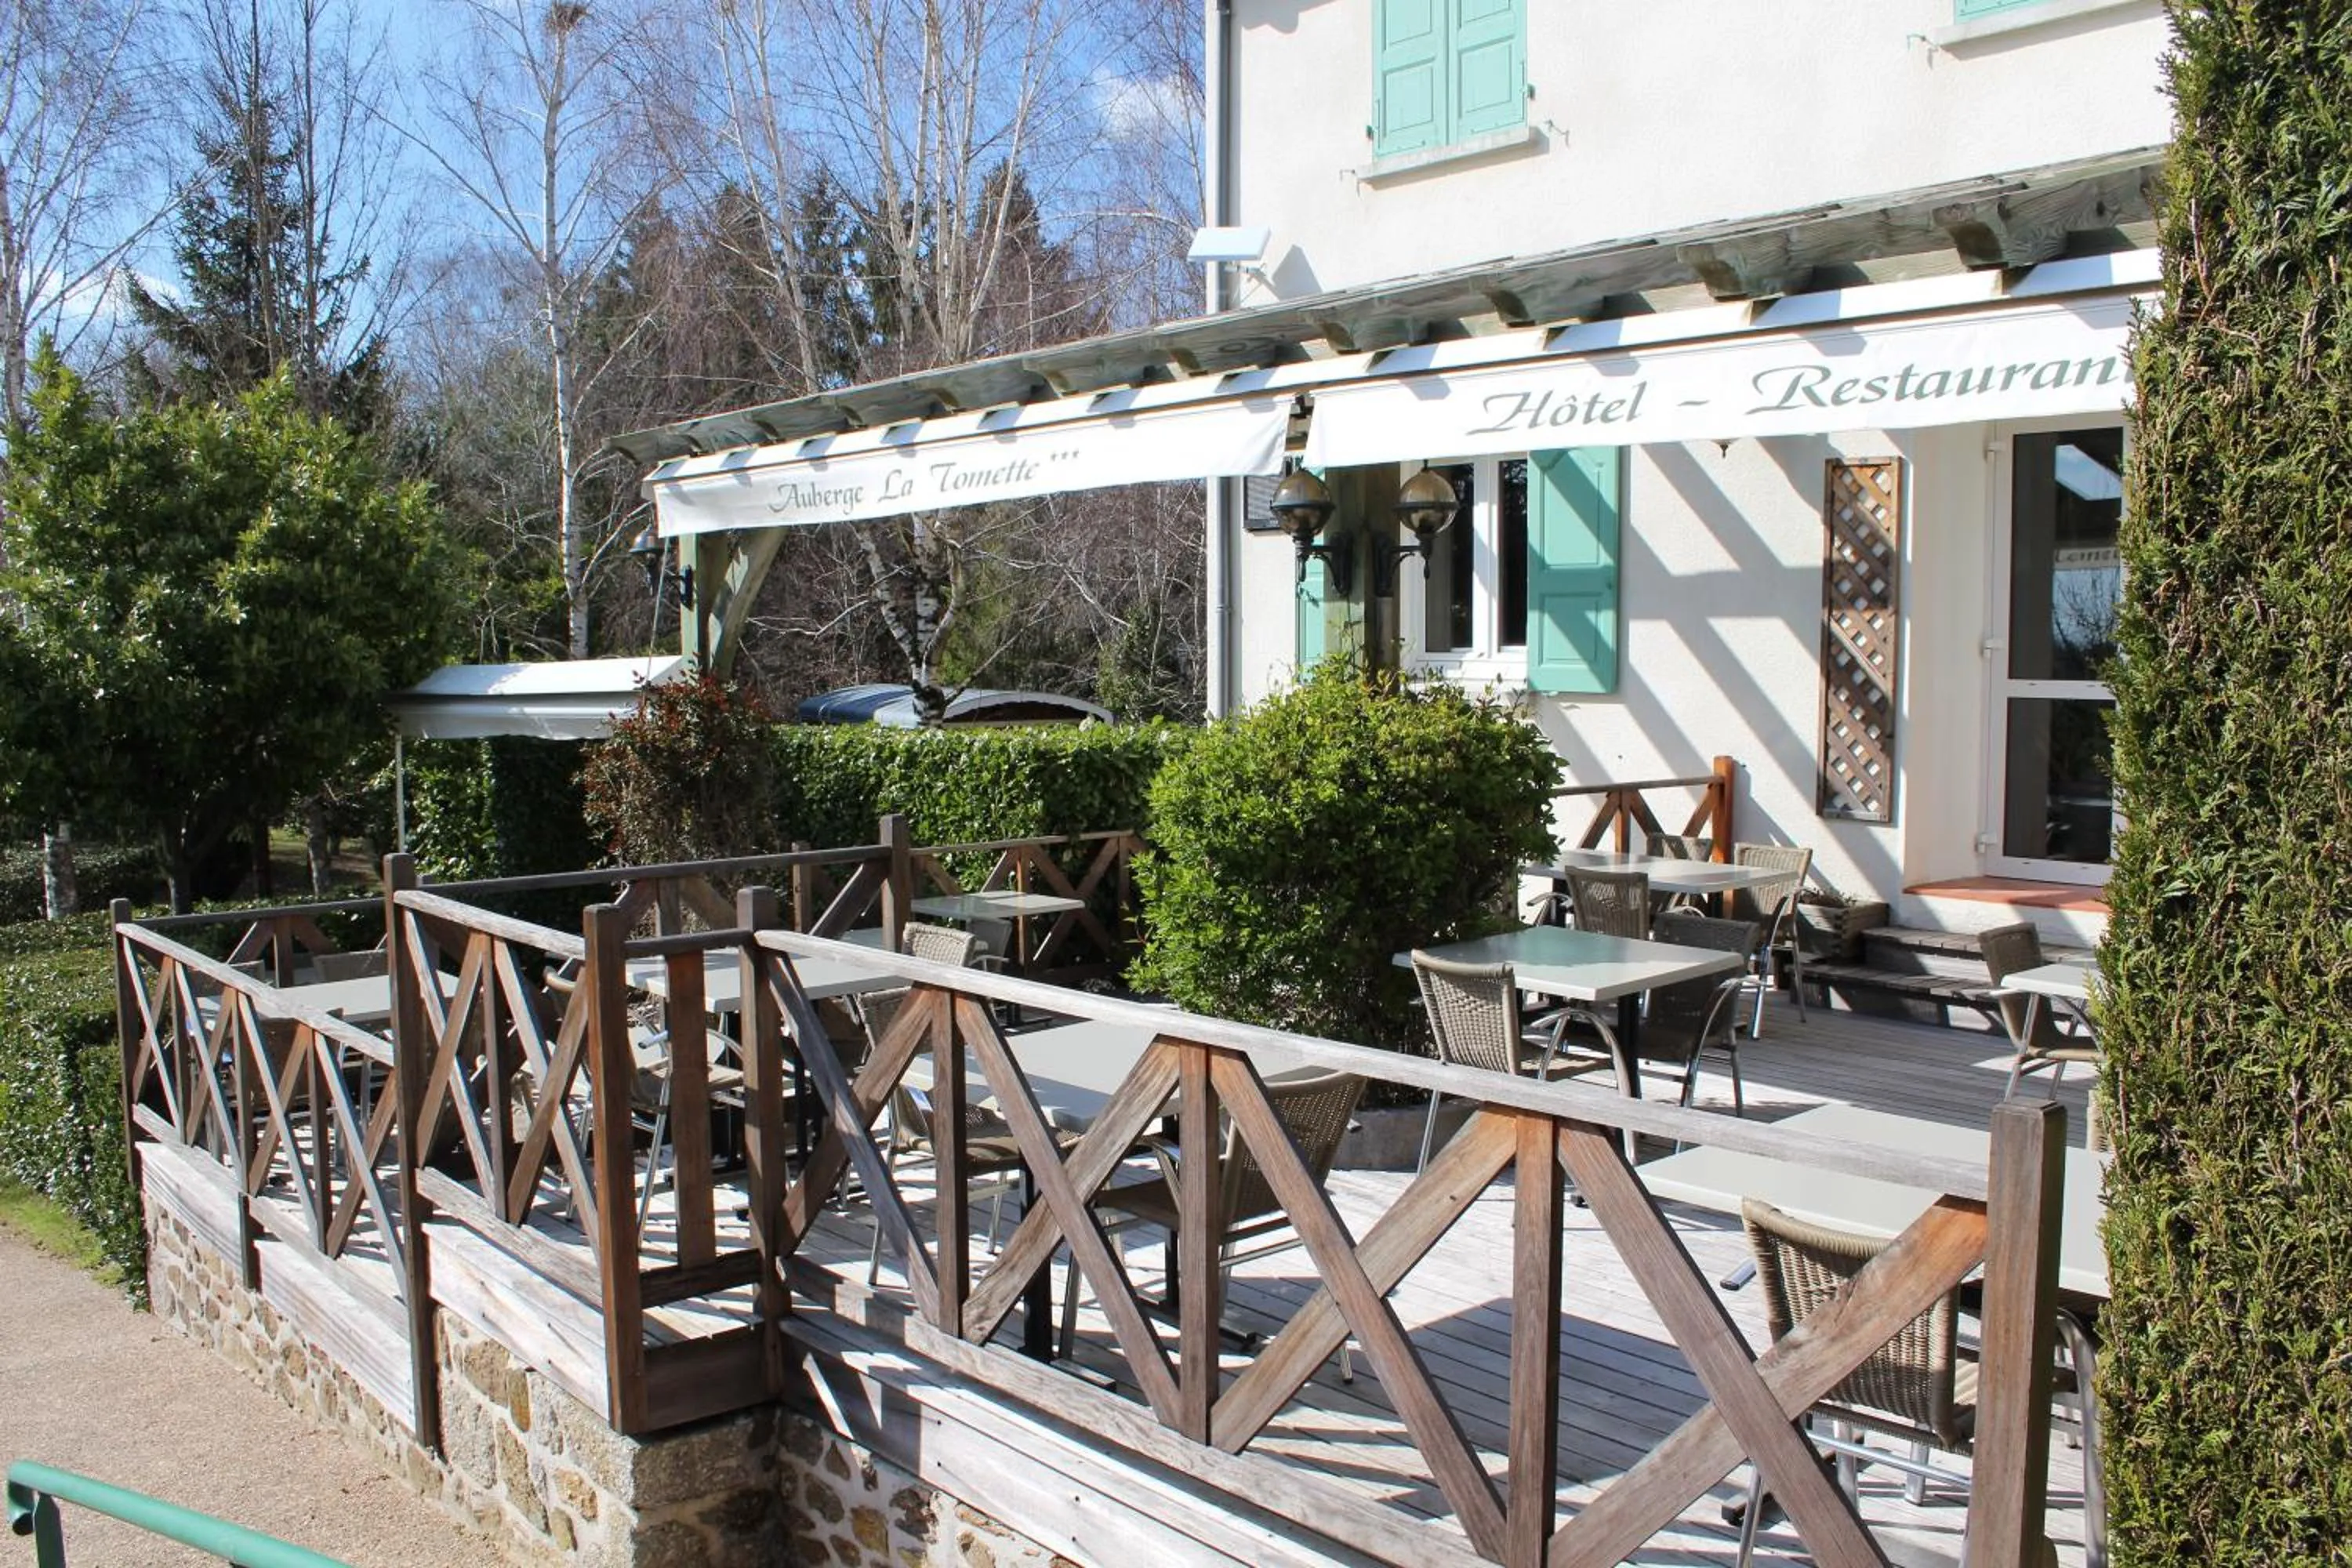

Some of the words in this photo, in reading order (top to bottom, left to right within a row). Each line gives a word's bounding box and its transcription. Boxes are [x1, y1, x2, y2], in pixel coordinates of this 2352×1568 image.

[1466, 380, 1648, 437] Hôtel
[1744, 355, 2134, 416] Restauran
[768, 483, 864, 515] Auberge
[878, 469, 913, 503] La
[930, 459, 1041, 493] Tomette
